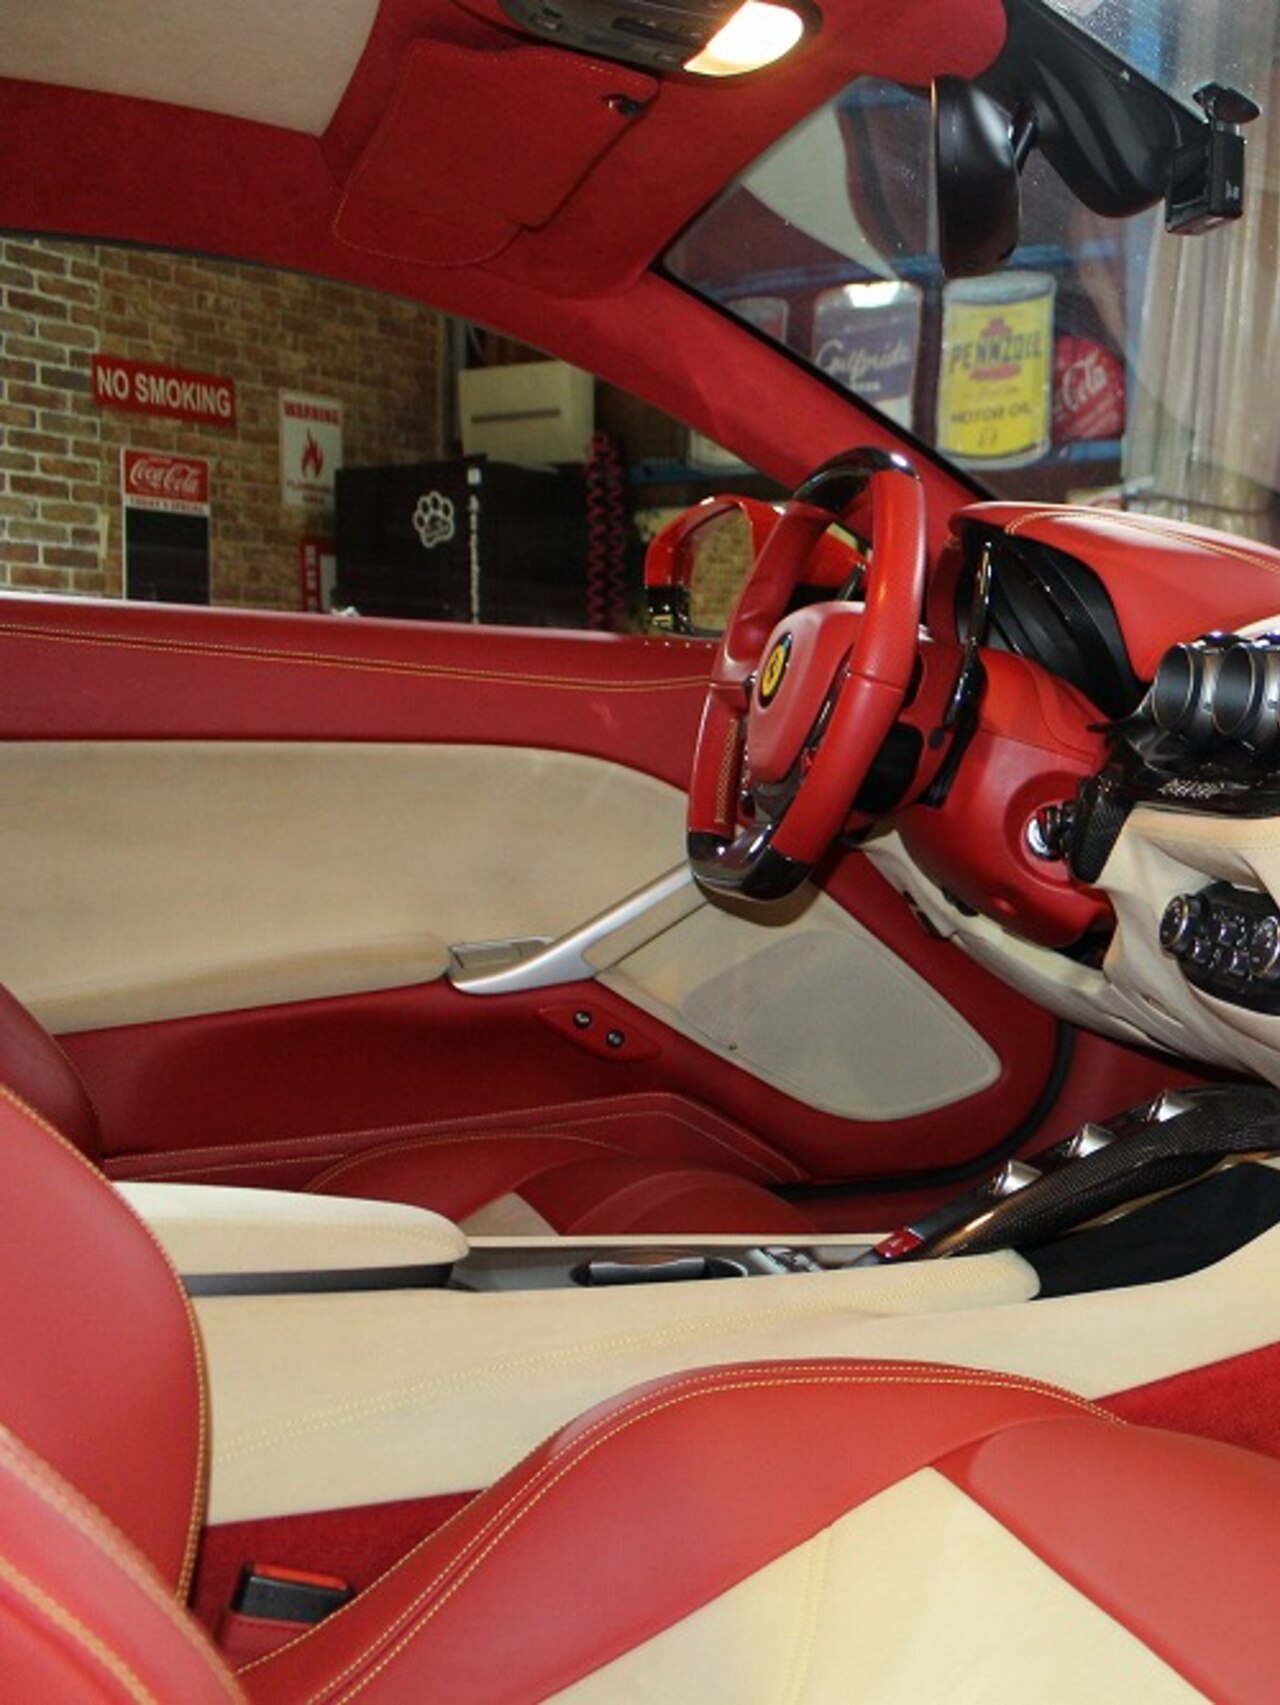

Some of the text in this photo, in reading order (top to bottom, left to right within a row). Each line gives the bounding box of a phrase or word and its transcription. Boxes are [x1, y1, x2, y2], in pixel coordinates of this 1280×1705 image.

[950, 331, 1041, 372] PENNZOIL
[97, 366, 232, 418] NO SMOKING
[284, 402, 339, 425] WARNING
[950, 401, 1032, 424] MOTOR OIL
